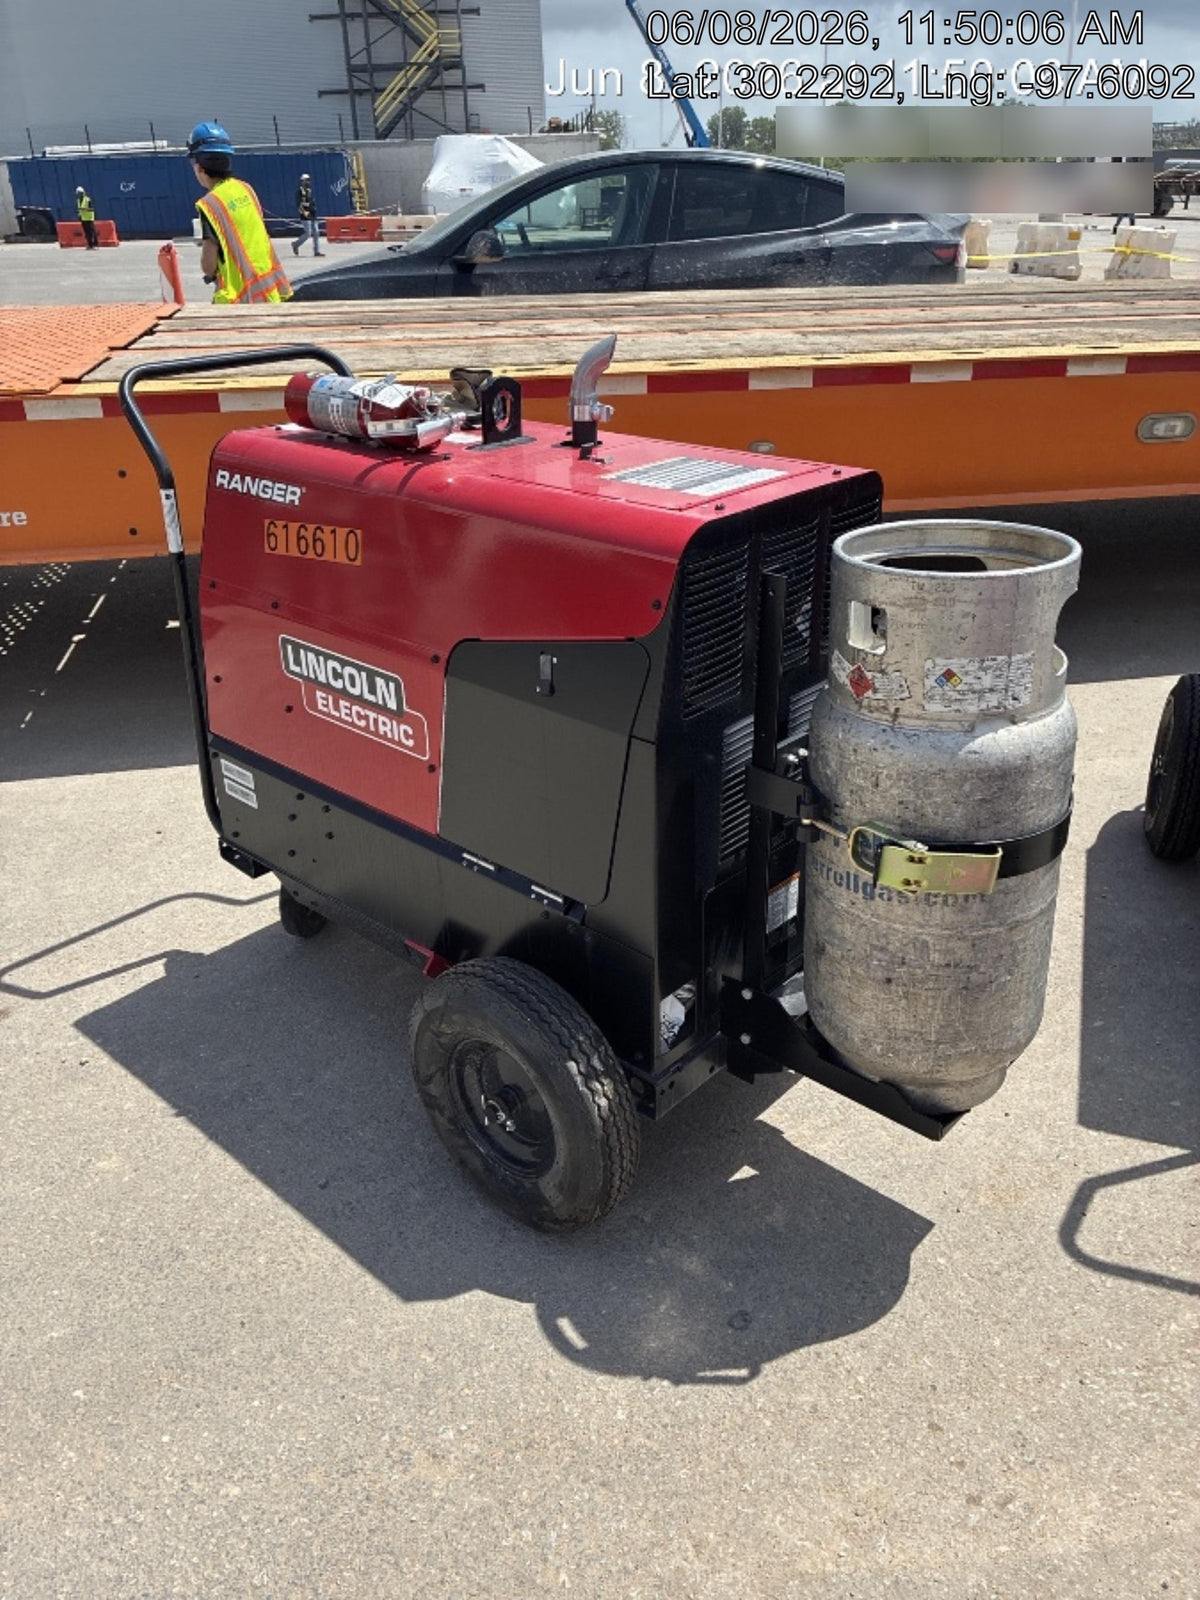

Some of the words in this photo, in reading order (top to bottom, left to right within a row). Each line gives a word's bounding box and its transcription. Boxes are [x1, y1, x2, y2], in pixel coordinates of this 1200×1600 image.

[266, 520, 360, 562] 616610
[287, 644, 397, 711] LINCOLN
[316, 689, 415, 747] ELECTRIC
